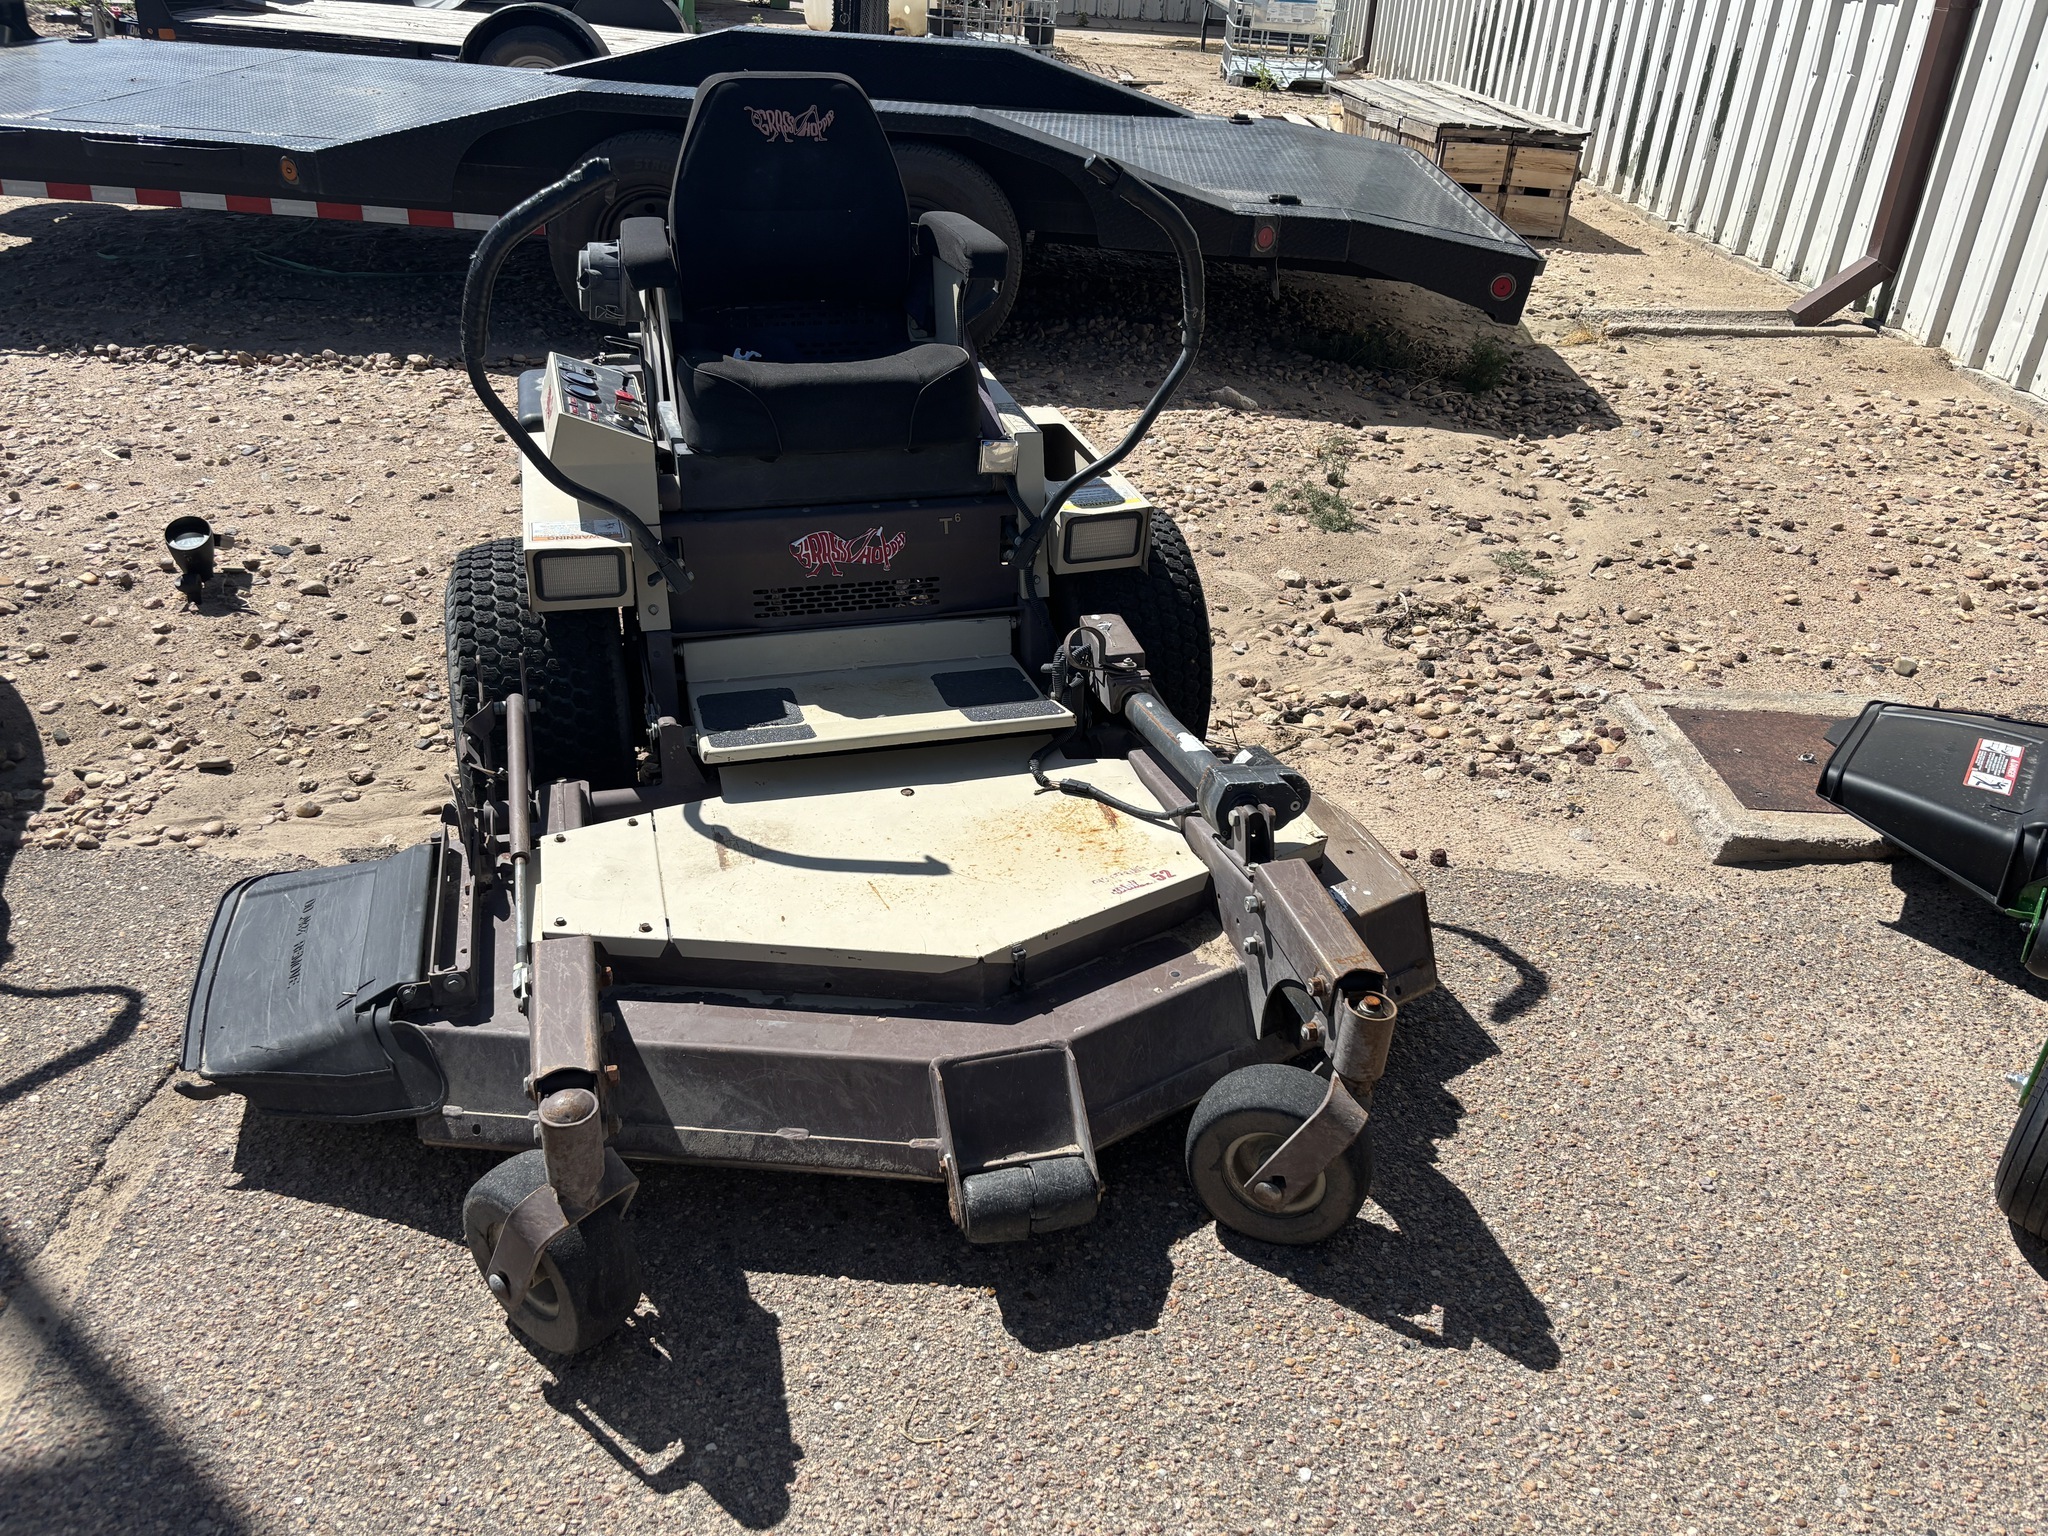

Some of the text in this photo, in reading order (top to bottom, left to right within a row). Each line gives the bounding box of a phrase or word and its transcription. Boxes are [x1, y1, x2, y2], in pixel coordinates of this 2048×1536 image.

[1149, 869, 1177, 881] 52
[302, 898, 317, 914] DO
[286, 940, 306, 989] REMOVE
